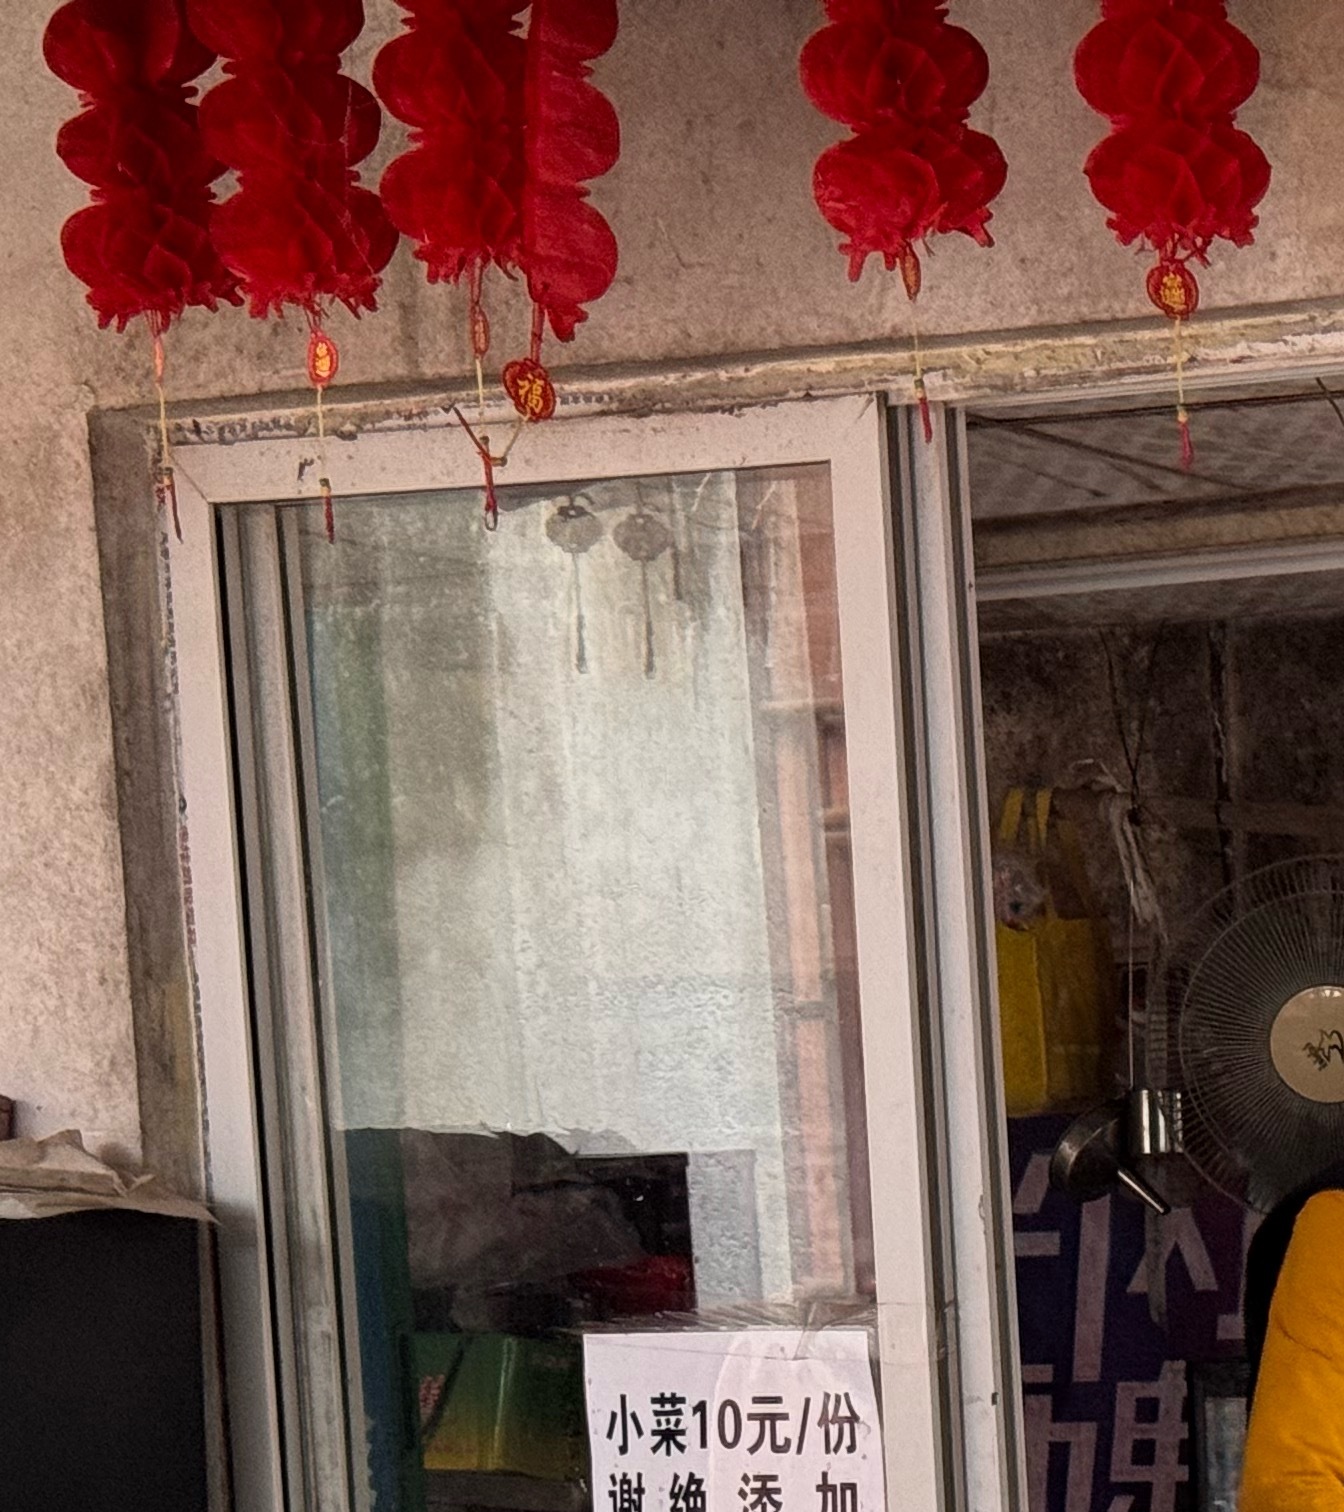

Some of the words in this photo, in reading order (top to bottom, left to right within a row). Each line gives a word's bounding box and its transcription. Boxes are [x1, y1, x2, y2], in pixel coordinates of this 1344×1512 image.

[518, 374, 543, 414] 福
[605, 1391, 861, 1457] 小菜10元/份
